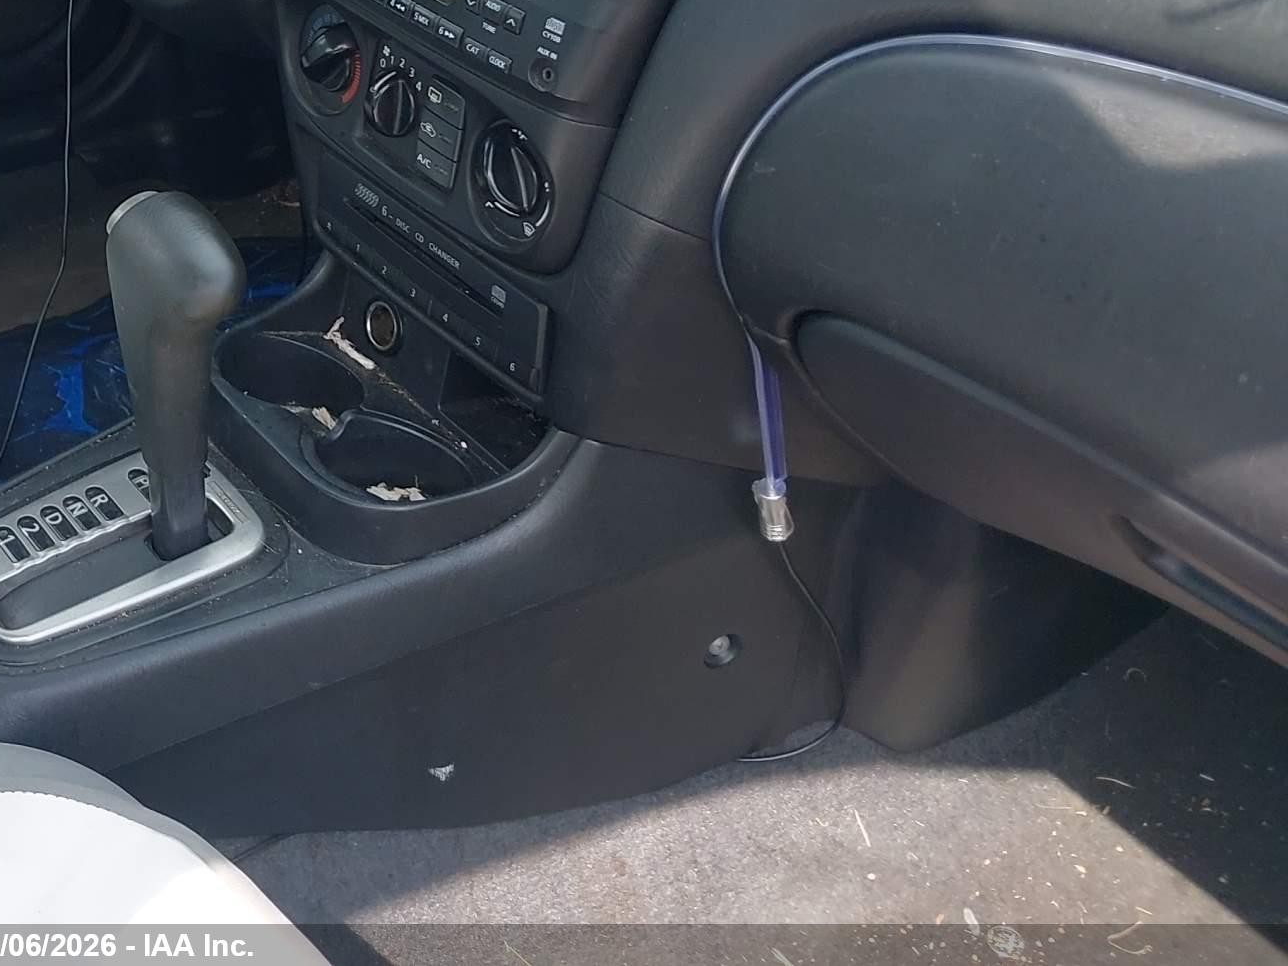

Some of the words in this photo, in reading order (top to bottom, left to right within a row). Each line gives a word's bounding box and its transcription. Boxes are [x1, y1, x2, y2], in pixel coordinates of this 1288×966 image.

[466, 44, 481, 55] CAT
[399, 57, 405, 68] 2
[417, 154, 432, 169] A/C
[428, 241, 461, 271] CHANGER
[90, 493, 108, 508] R
[68, 503, 88, 517] N
[44, 512, 62, 525] D
[21, 523, 40, 536] 2
